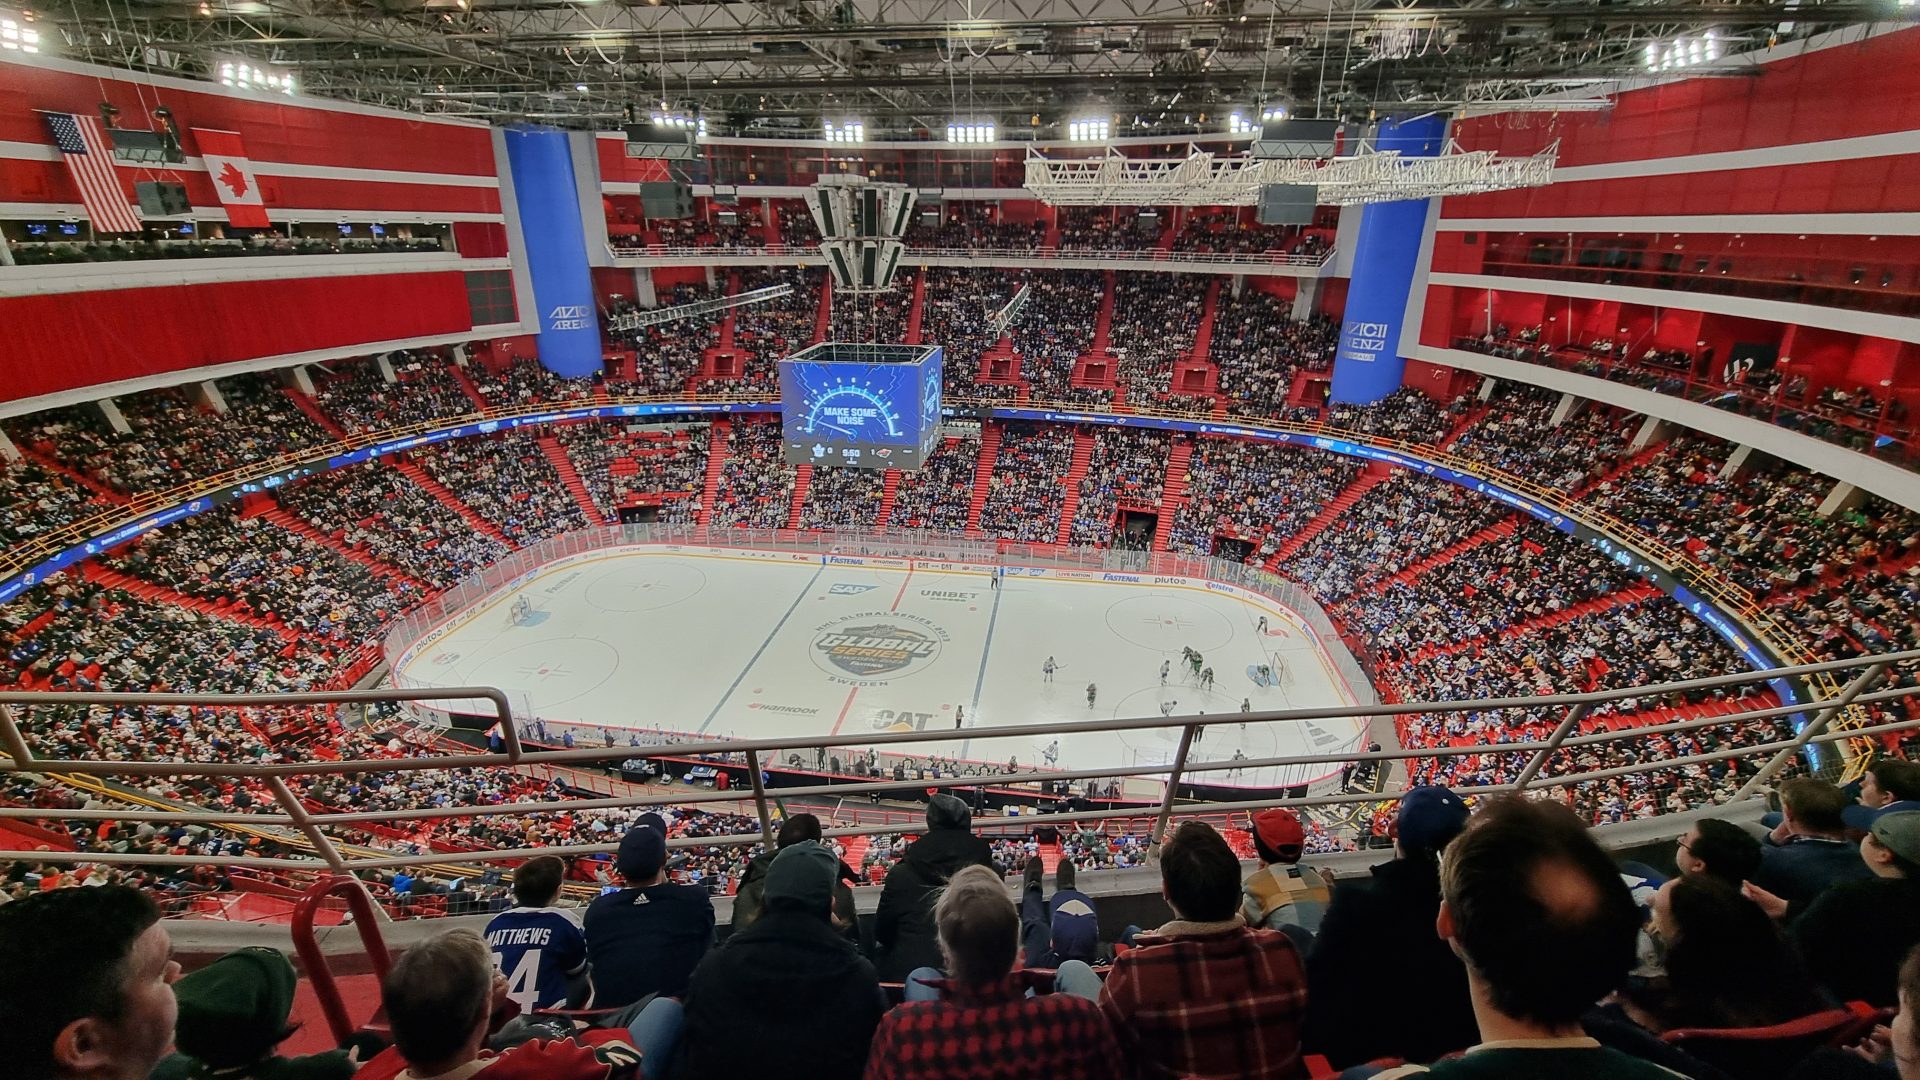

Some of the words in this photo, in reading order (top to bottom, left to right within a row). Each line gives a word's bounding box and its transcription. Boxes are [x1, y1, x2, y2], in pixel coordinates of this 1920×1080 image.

[823, 407, 849, 416] MAKE
[851, 408, 877, 417] SOME
[837, 416, 865, 425] NOISE
[1103, 573, 1140, 582] FASTENAL
[831, 585, 867, 594] SAP
[920, 590, 979, 599] UNIBET
[815, 620, 838, 632] NHL
[839, 611, 890, 621] GLOBAL
[893, 612, 931, 625] SERIES
[416, 632, 437, 653] pluto
[818, 633, 937, 656] GLOBAL
[830, 646, 911, 660] SERIES
[828, 675, 889, 687] SWEDEN
[872, 709, 933, 732] CAT
